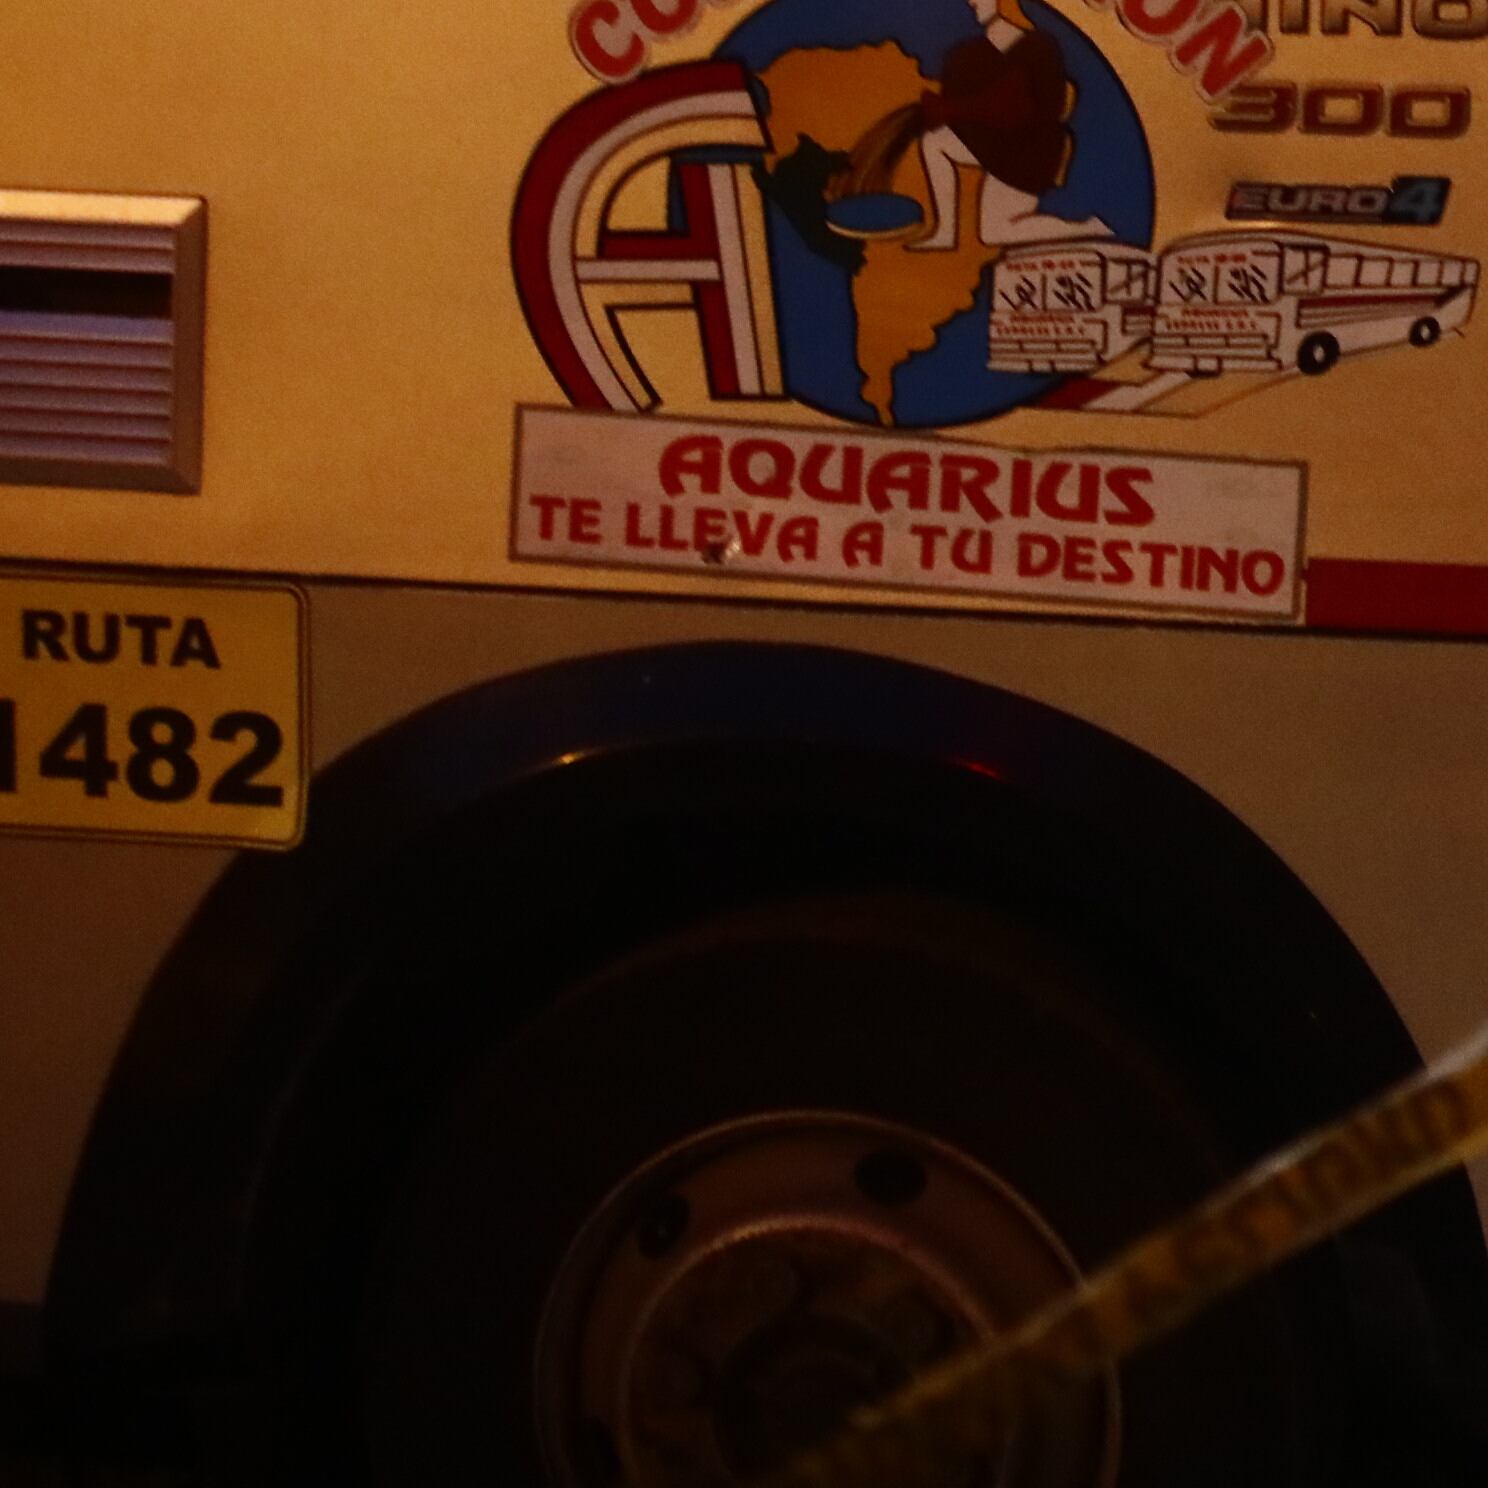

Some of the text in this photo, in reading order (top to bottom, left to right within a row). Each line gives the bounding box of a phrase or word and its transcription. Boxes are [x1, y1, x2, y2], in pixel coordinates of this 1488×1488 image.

[1207, 80, 1472, 140] 300
[658, 434, 1155, 527] AQUARIUS
[529, 494, 1286, 596] TE LLEVA A TU DESTINO
[21, 609, 221, 669] RUTA
